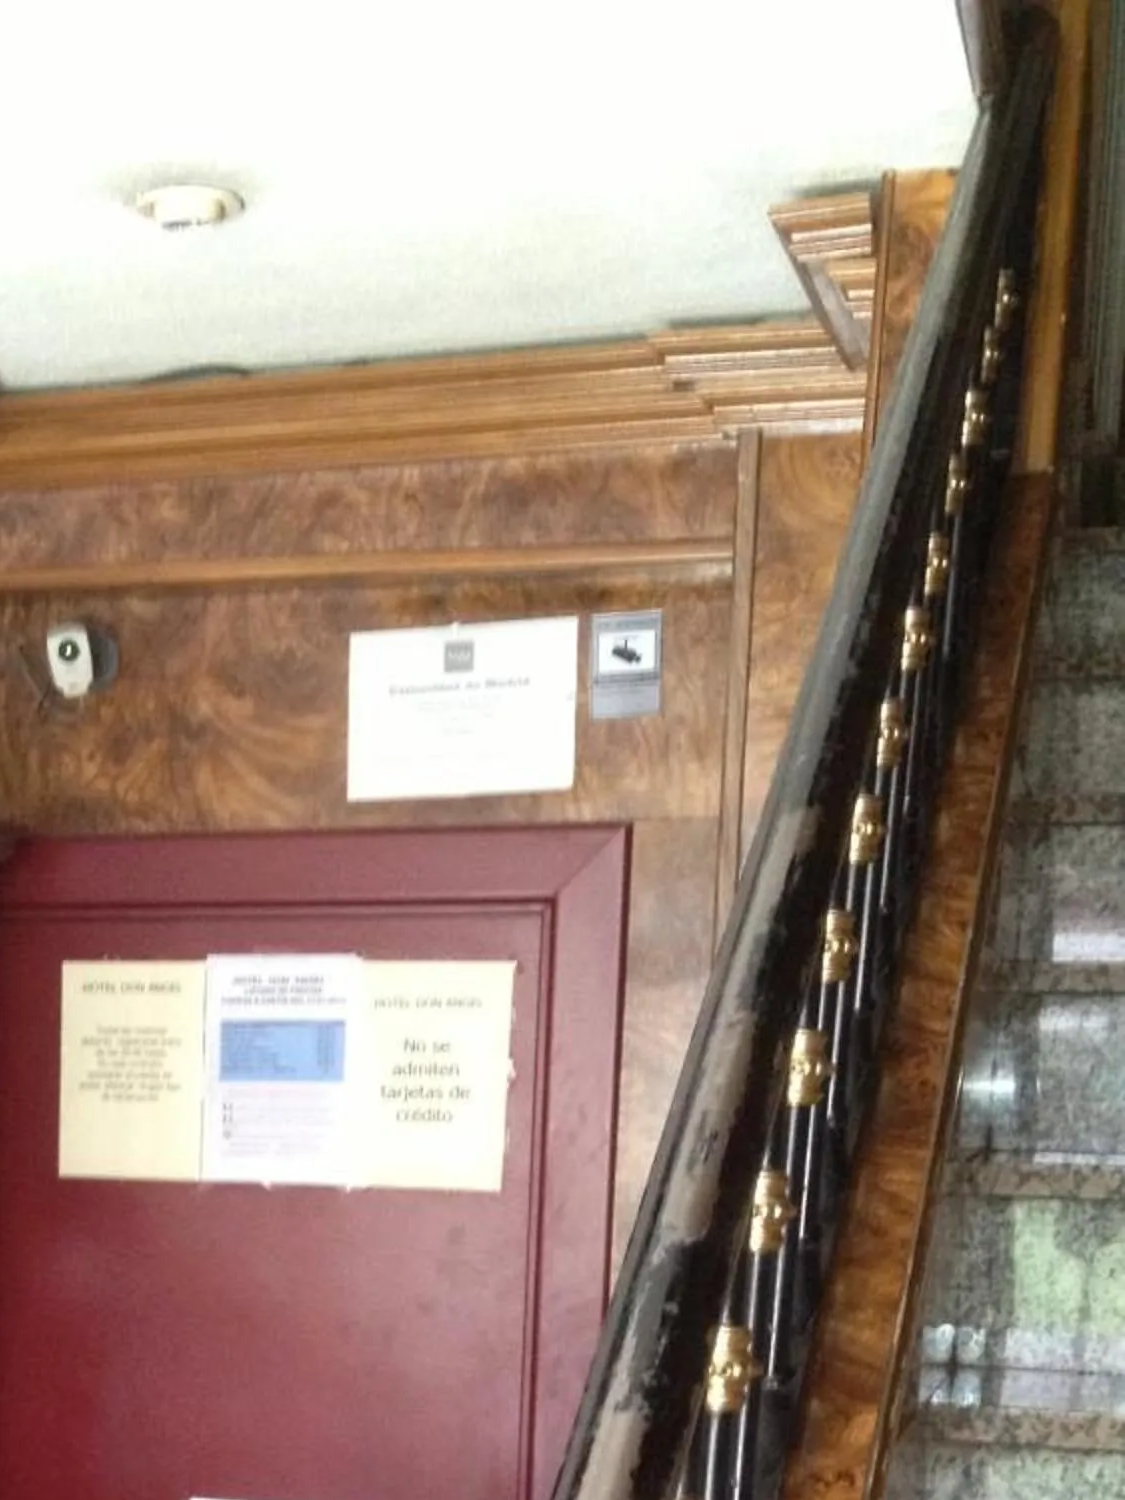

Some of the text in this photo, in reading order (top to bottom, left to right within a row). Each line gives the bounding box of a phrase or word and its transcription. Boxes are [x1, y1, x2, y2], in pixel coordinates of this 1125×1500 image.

[403, 1037, 451, 1053] No se
[392, 1061, 460, 1076] admiten
[380, 1084, 471, 1102] tarjetas de
[395, 1107, 454, 1123] crédito
